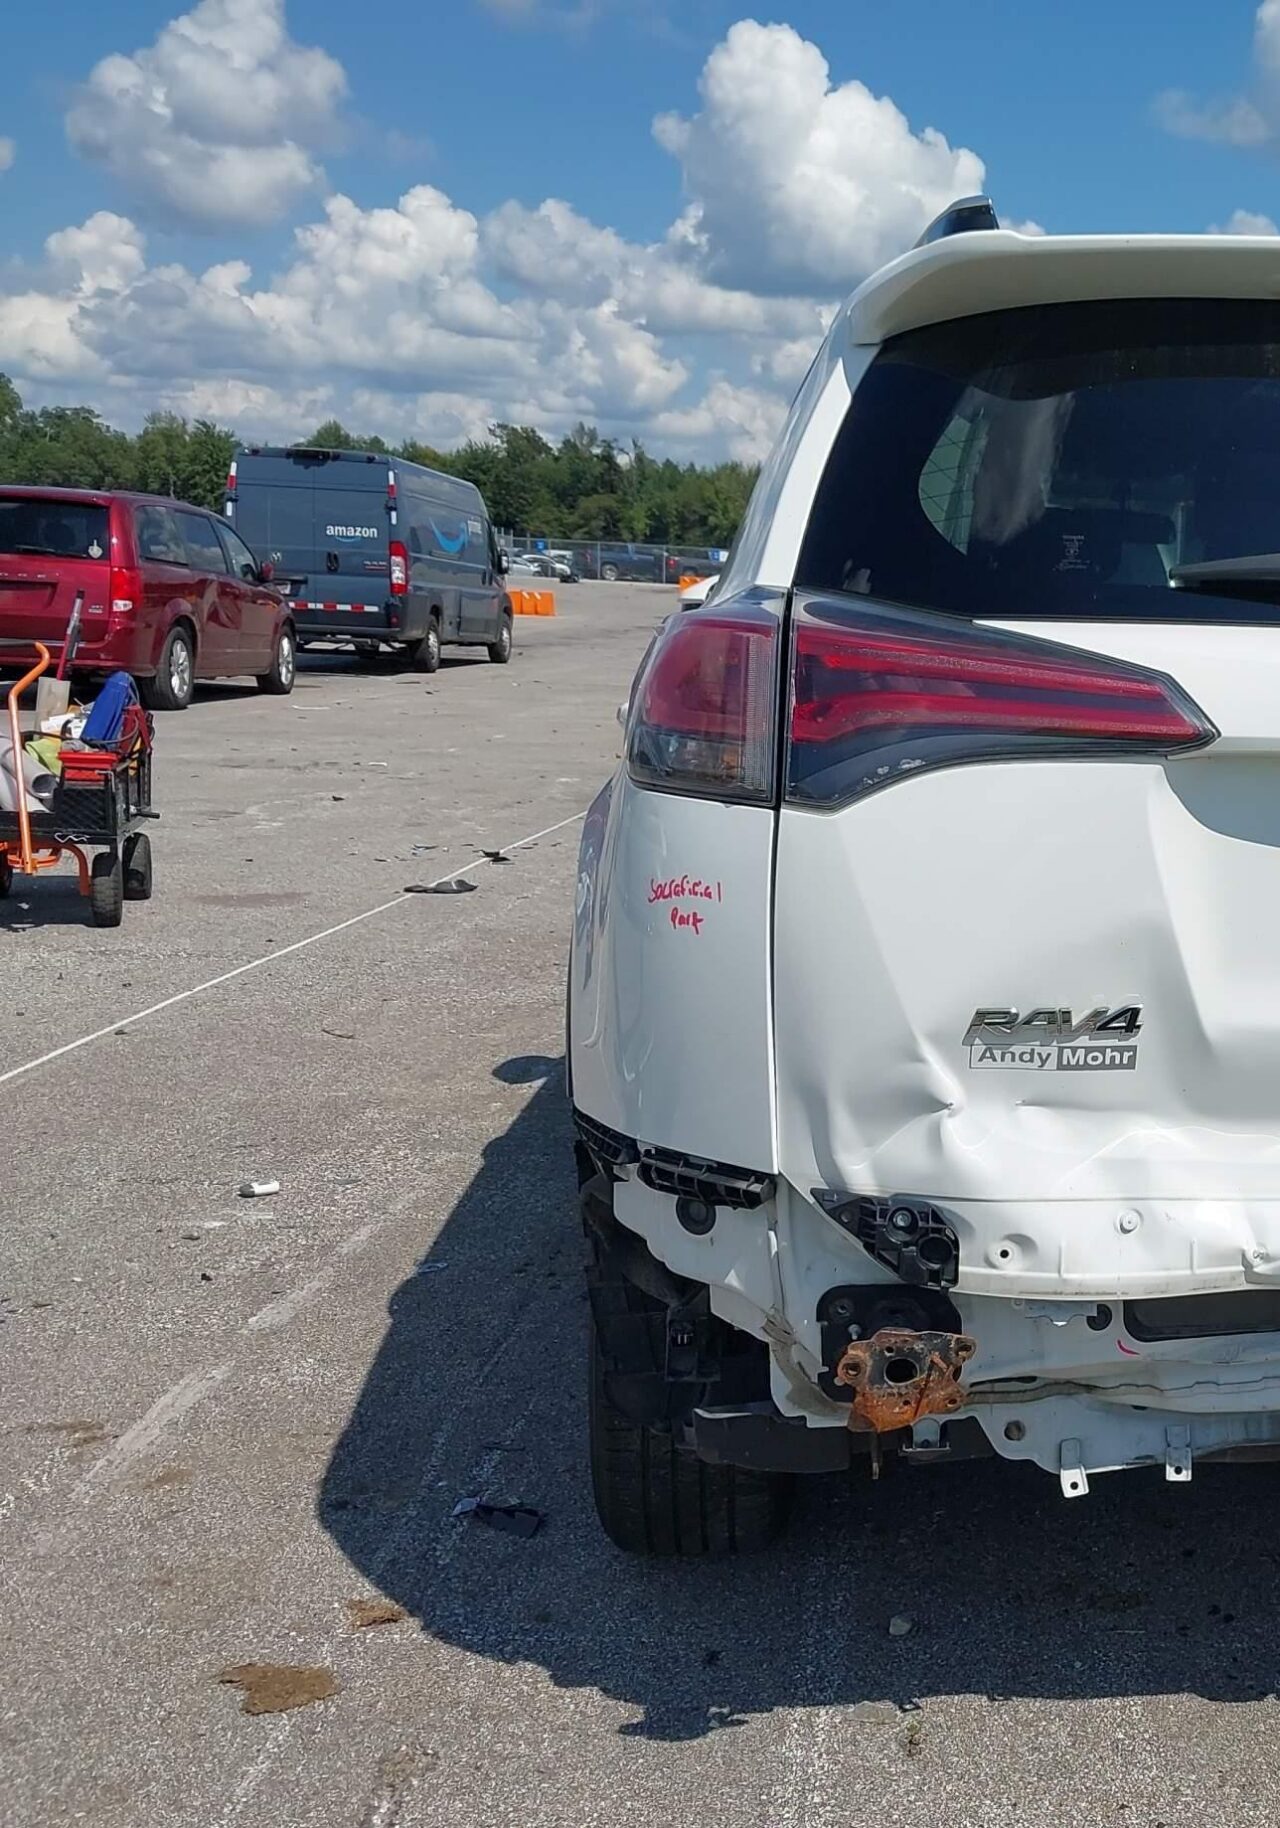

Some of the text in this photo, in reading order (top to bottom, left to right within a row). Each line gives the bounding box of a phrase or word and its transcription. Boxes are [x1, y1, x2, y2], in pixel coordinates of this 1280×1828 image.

[326, 525, 378, 538] amazon
[967, 1004, 1144, 1042] RAV4
[977, 1047, 1134, 1068] Andy Mohr
